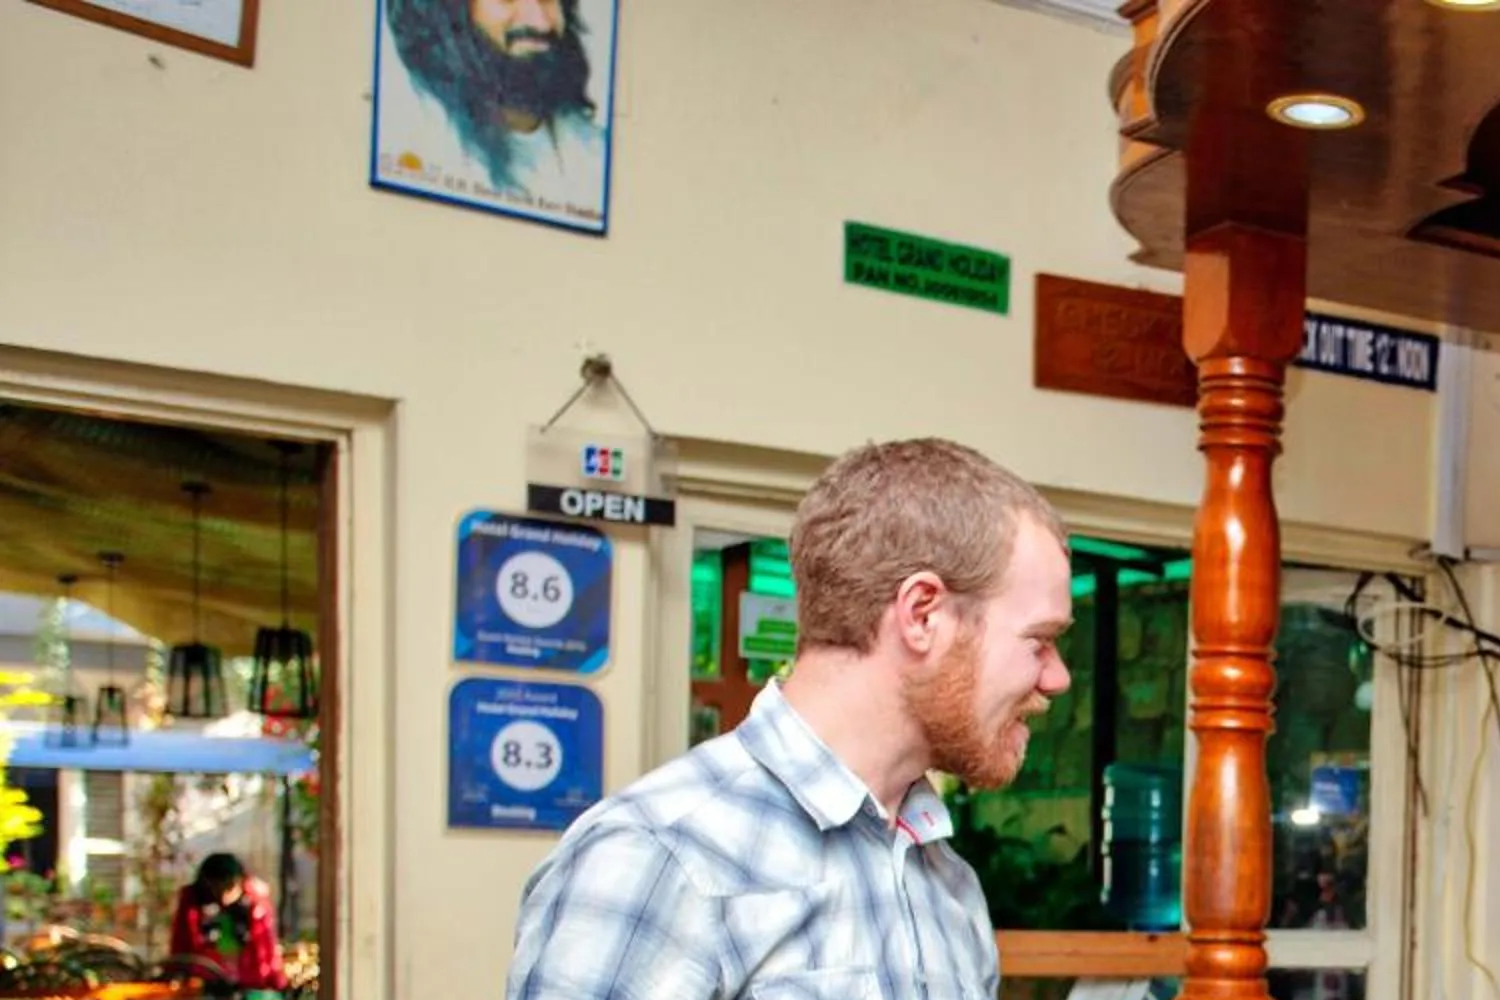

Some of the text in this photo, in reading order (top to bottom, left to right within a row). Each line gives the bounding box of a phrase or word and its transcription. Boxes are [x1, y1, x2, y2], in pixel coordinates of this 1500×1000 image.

[560, 488, 645, 523] OPEN
[510, 571, 561, 603] 8.6
[502, 740, 553, 769] 8.3
